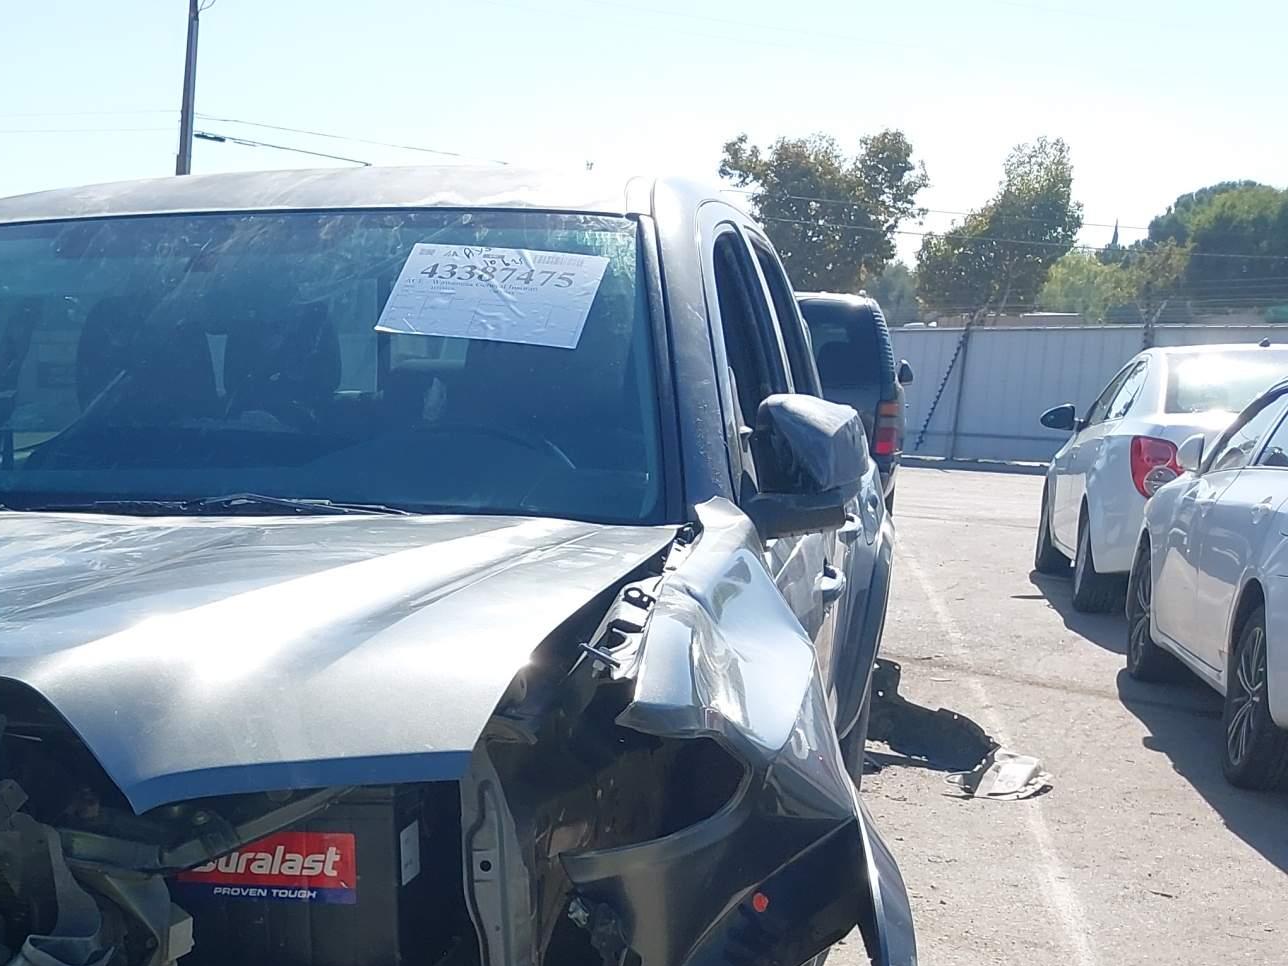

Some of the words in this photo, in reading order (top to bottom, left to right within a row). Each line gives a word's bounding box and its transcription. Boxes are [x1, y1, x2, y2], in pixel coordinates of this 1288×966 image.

[420, 263, 576, 288] 43387475
[213, 887, 268, 898] PROVEN
[271, 889, 317, 899] TOUGH
